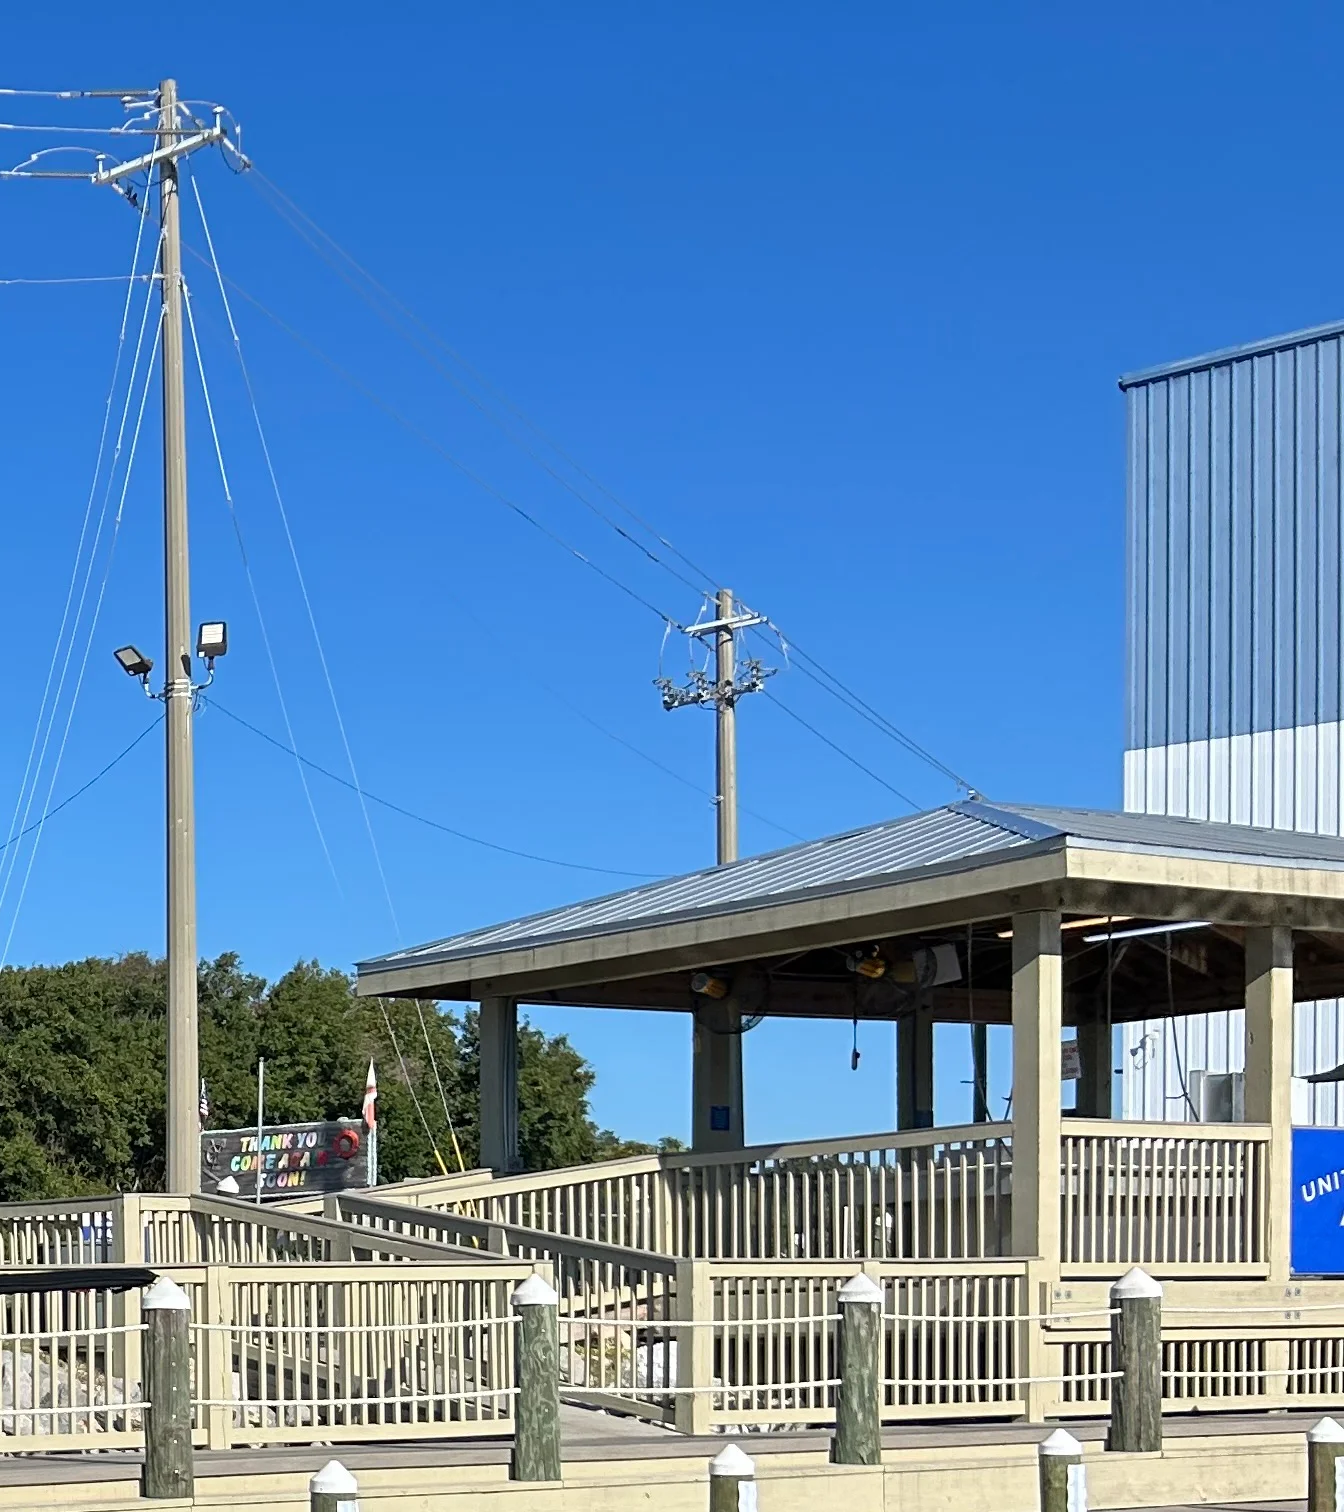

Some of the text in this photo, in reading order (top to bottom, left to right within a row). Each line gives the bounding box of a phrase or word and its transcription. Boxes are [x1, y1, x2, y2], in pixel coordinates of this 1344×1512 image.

[240, 1132, 328, 1152] THANK YOU
[230, 1153, 277, 1172] COME
[255, 1171, 306, 1189] SOON!
